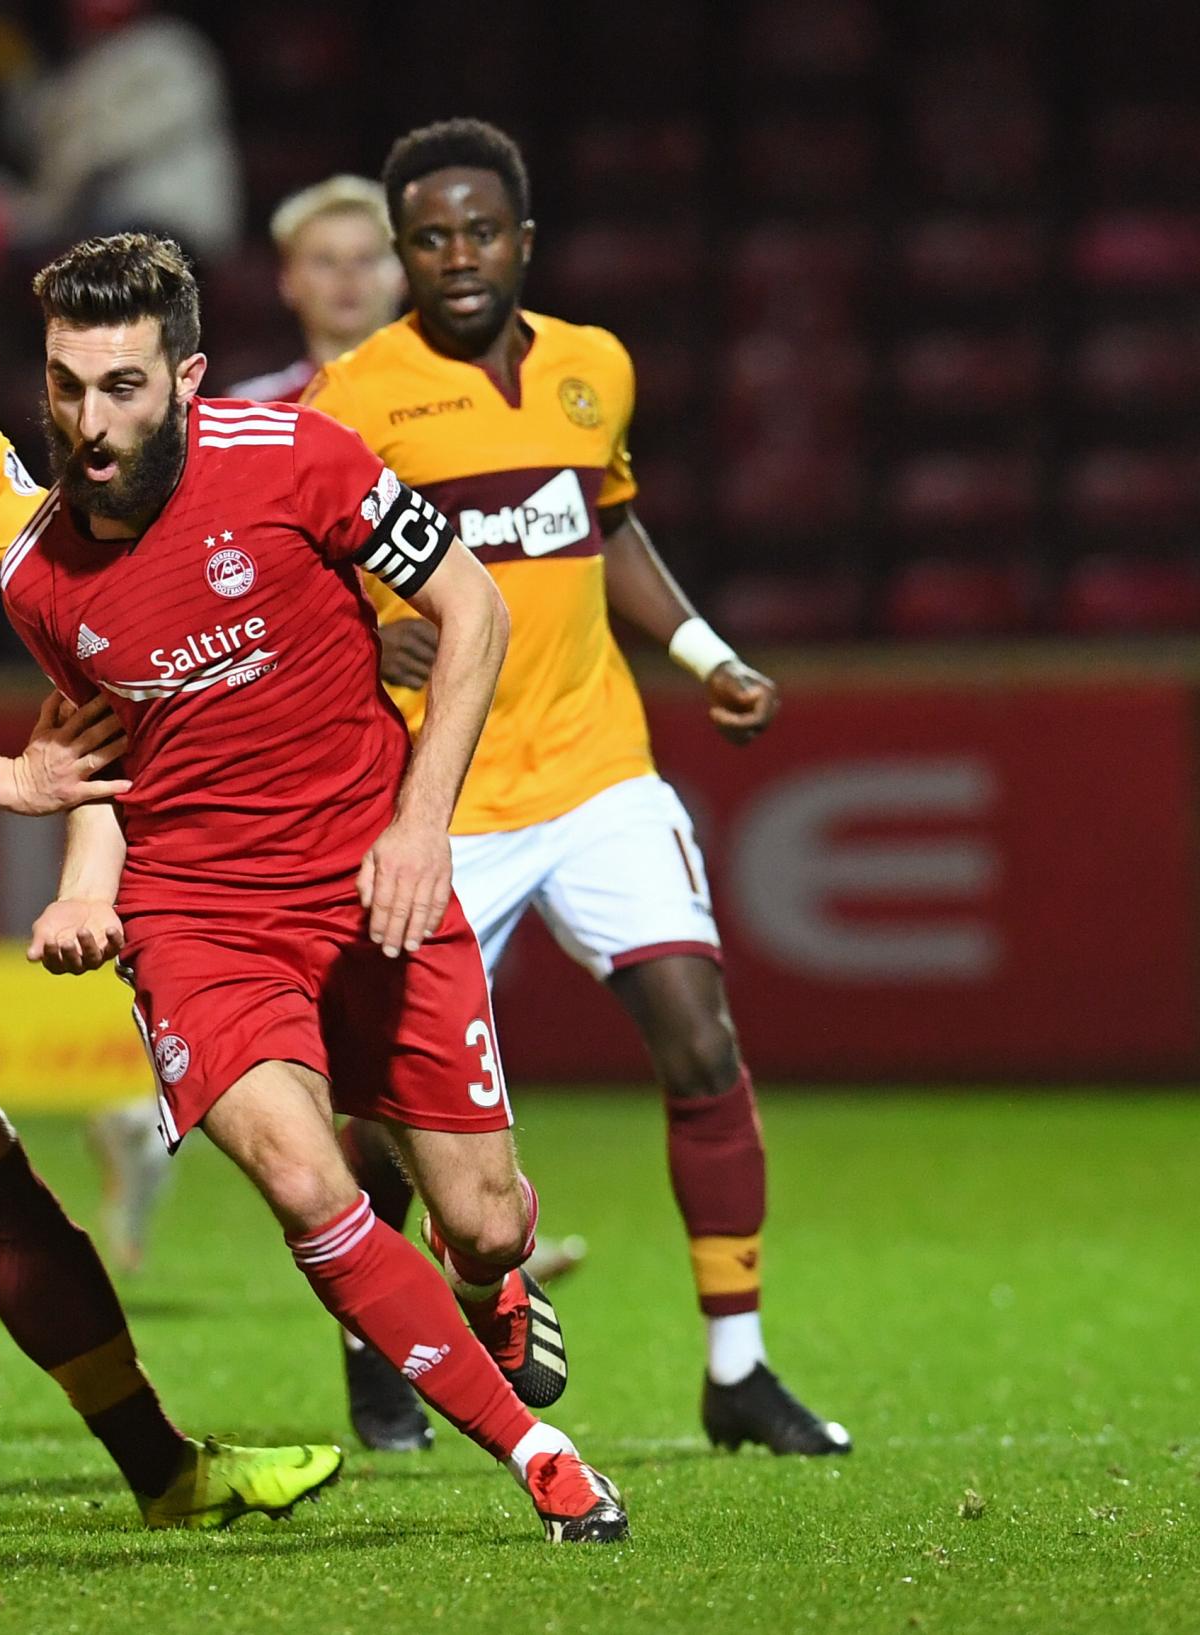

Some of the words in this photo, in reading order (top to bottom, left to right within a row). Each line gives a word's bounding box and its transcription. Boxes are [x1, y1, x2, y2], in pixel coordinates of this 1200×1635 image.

[76, 637, 110, 660] adidas
[150, 616, 267, 679] Saltire
[464, 1018, 501, 1108] 3
